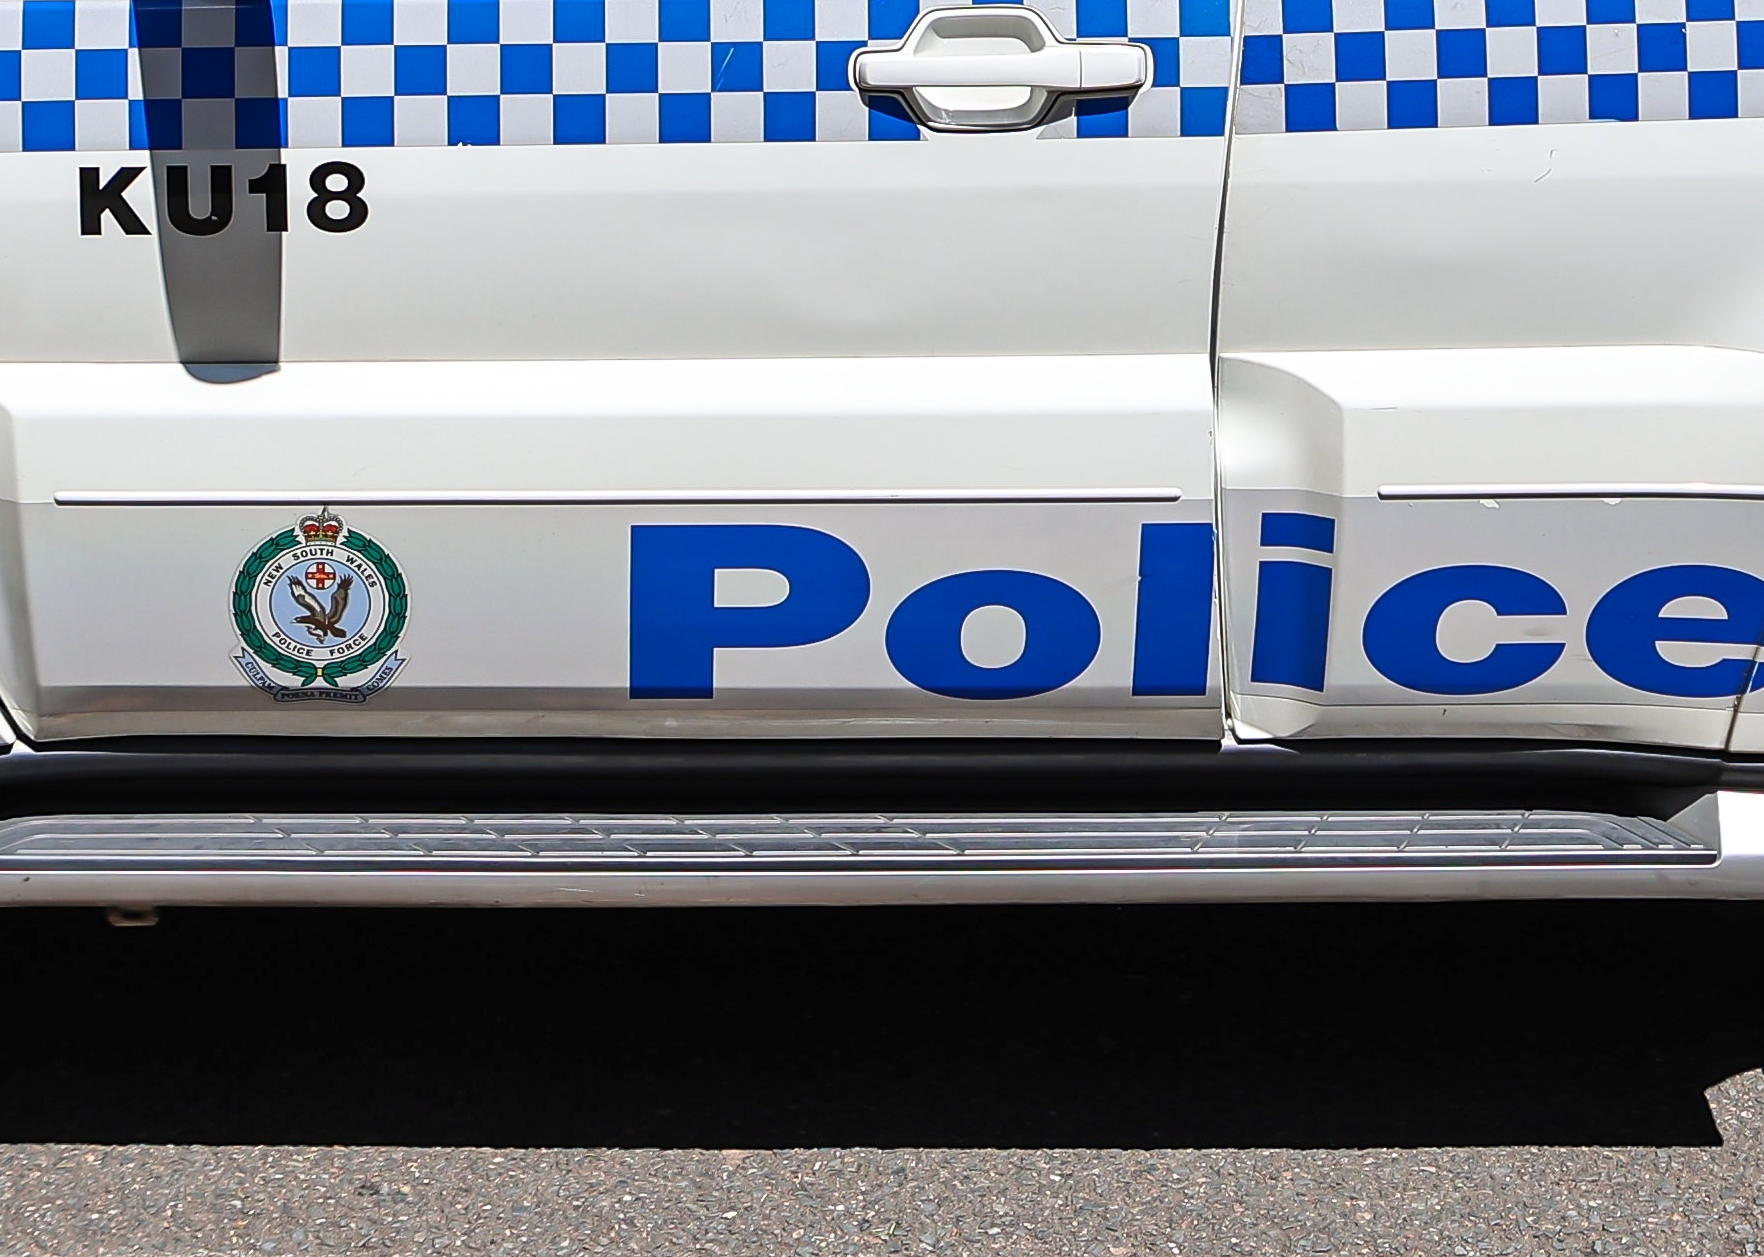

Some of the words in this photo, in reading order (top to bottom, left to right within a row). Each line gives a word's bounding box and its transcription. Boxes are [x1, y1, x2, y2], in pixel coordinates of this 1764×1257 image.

[78, 160, 369, 237] KU18
[263, 562, 285, 588] NEW
[291, 547, 334, 561] SOUTH
[346, 555, 378, 589] WALES
[272, 632, 314, 657] POLICE
[328, 633, 368, 657] FORCE
[244, 661, 277, 691] CULPAM
[366, 665, 394, 691] COMES
